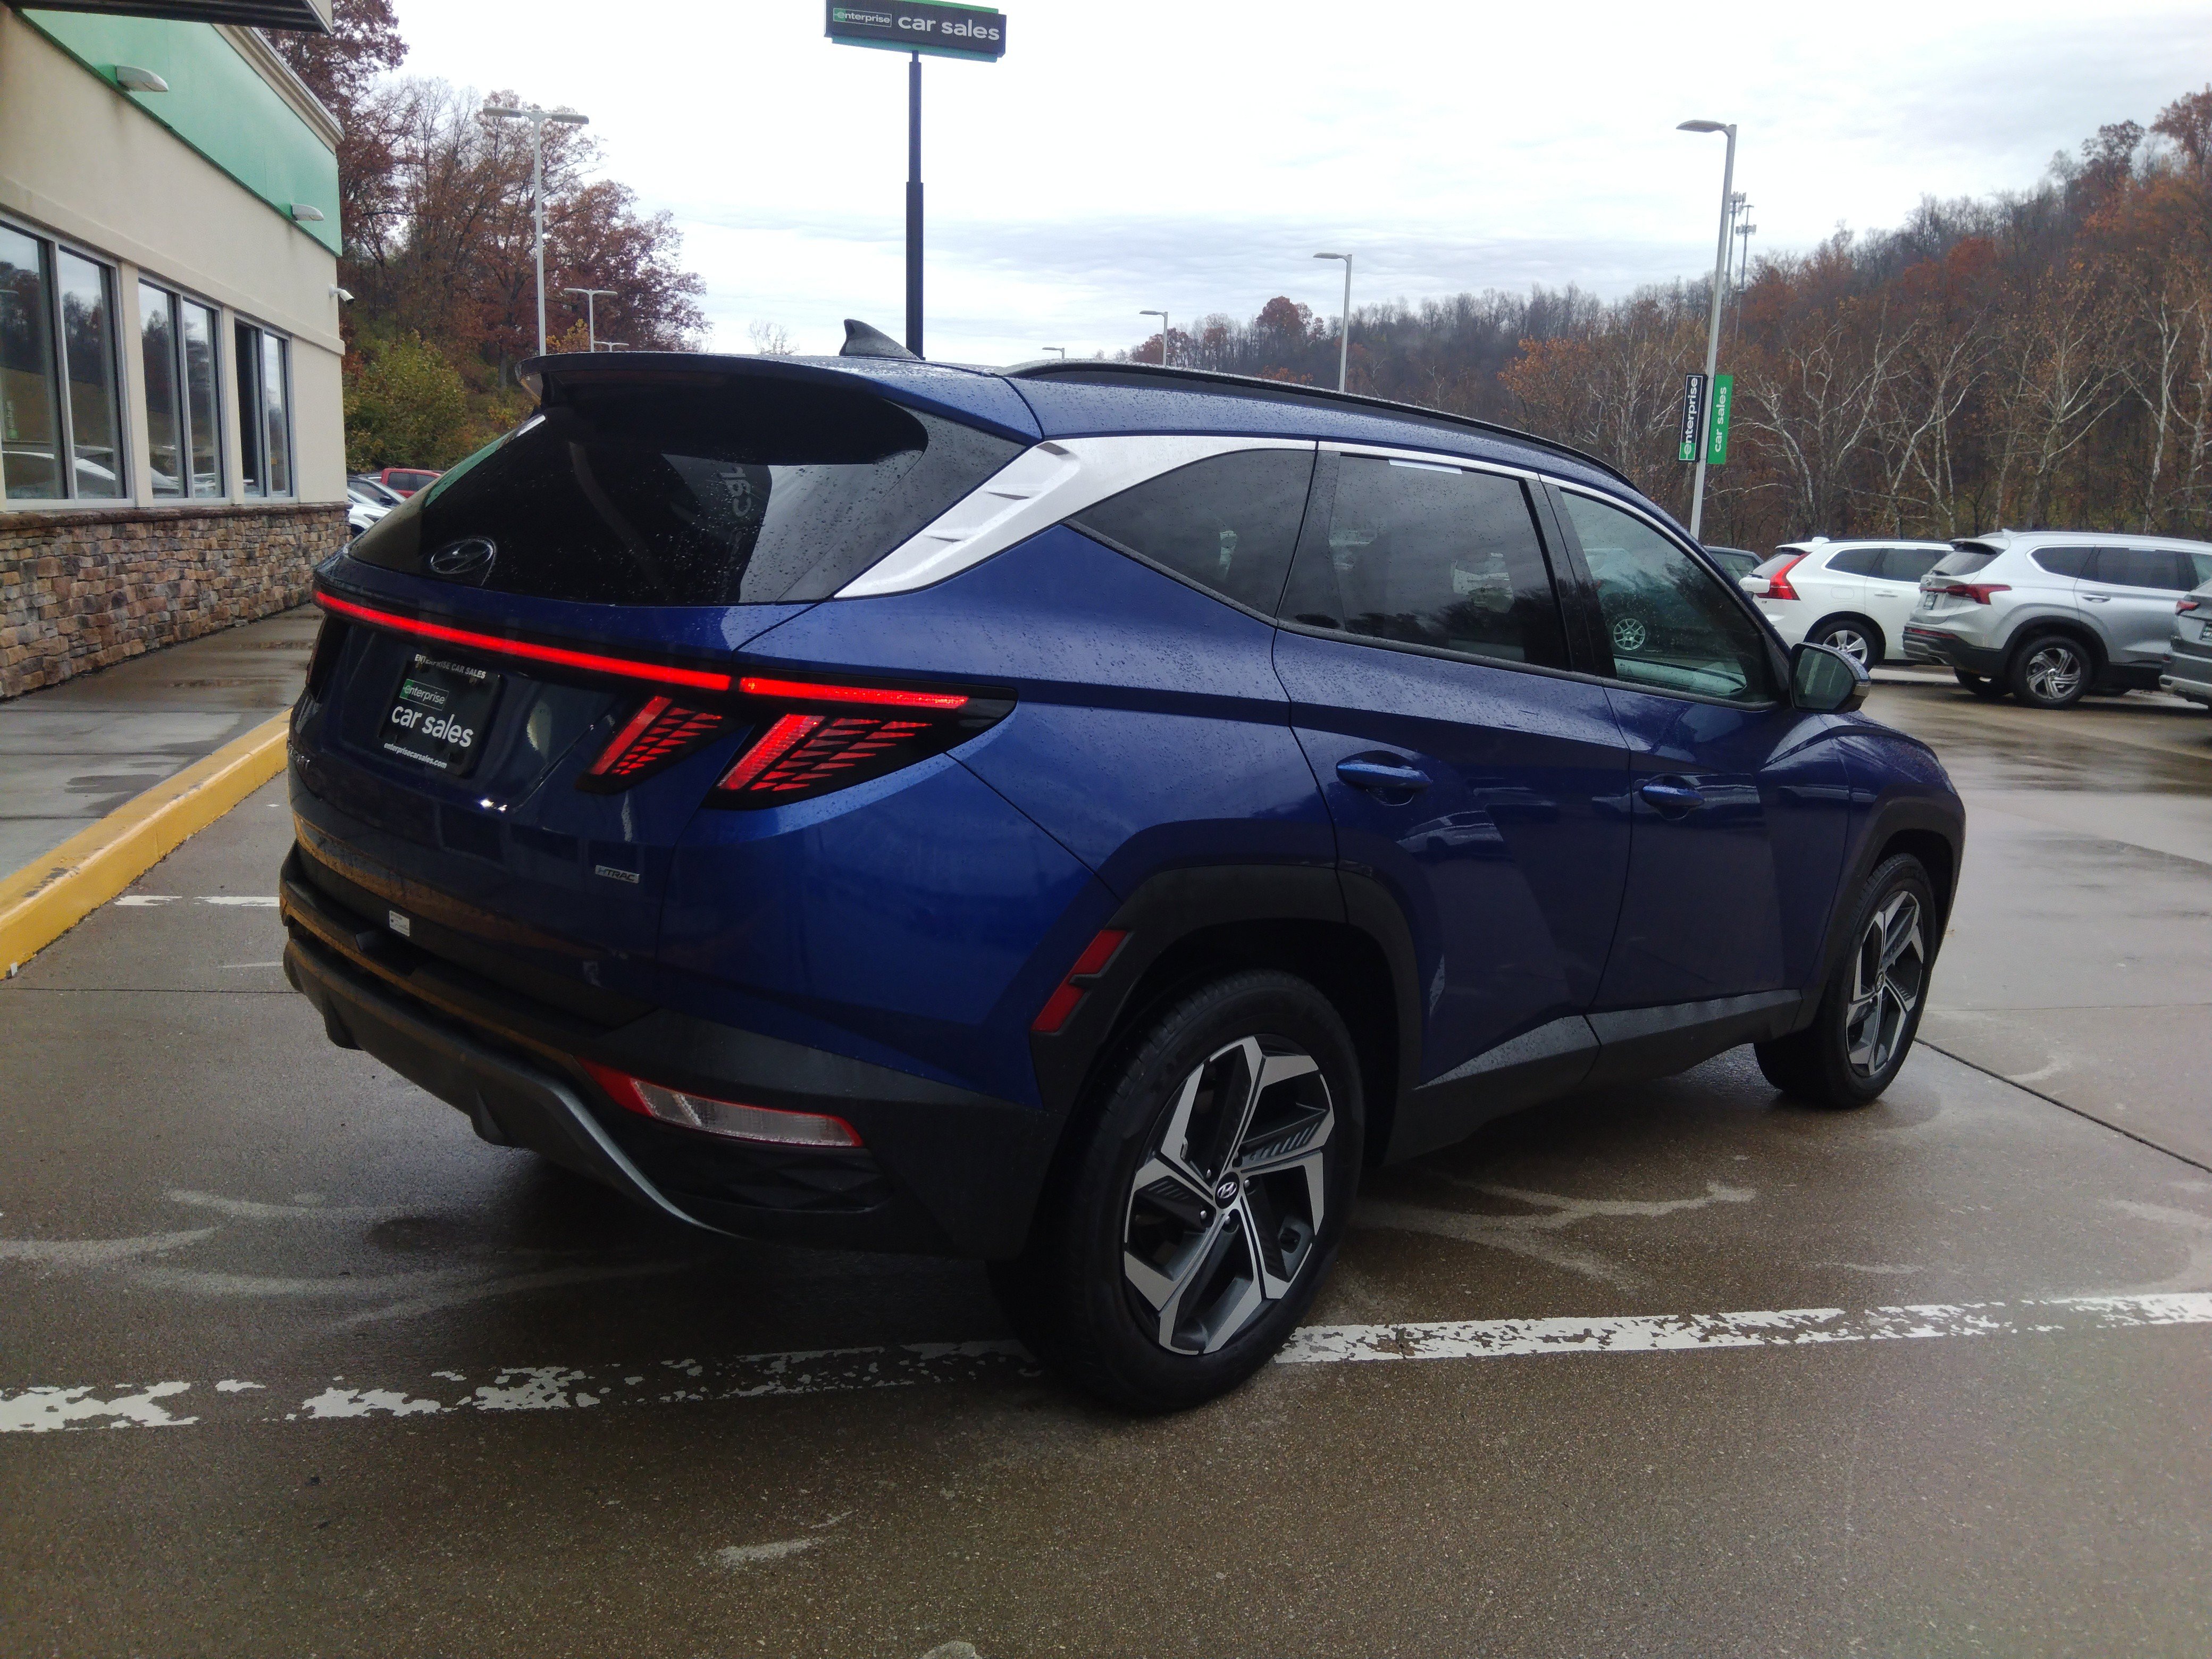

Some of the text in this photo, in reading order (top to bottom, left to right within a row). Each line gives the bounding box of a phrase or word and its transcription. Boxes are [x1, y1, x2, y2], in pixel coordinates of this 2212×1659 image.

[835, 11, 999, 40] enterprise car sales
[1684, 378, 1698, 456] enterprise
[1716, 387, 1727, 425] sales
[451, 664, 465, 673] CAR
[465, 667, 487, 679] SALES
[404, 684, 445, 704] enterprise
[392, 706, 473, 747] car sales
[384, 743, 447, 769] enterprisecarsales.com
